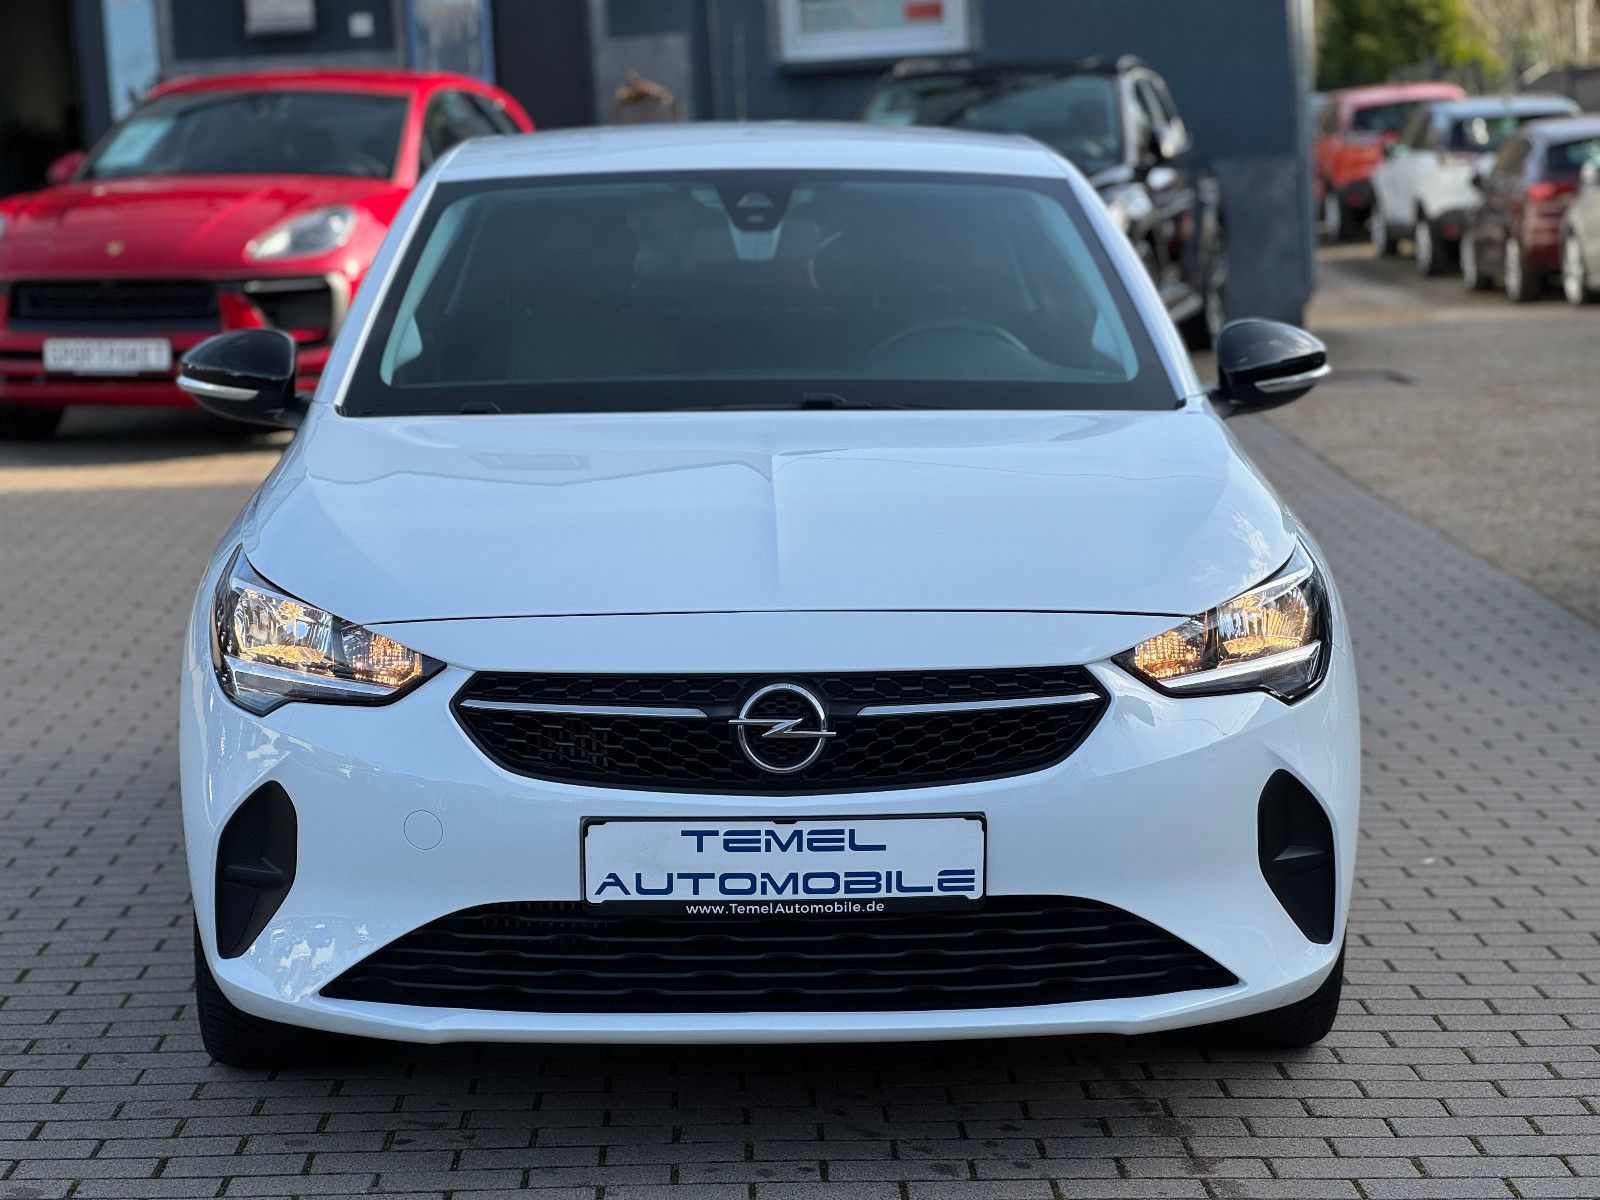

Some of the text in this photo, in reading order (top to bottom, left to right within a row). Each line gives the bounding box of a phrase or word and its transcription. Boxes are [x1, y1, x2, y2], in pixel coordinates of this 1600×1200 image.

[681, 829, 887, 853] TEMEL
[595, 868, 976, 896] AUTOMOBILE
[685, 901, 885, 915] www.TemelAutomobile.de
